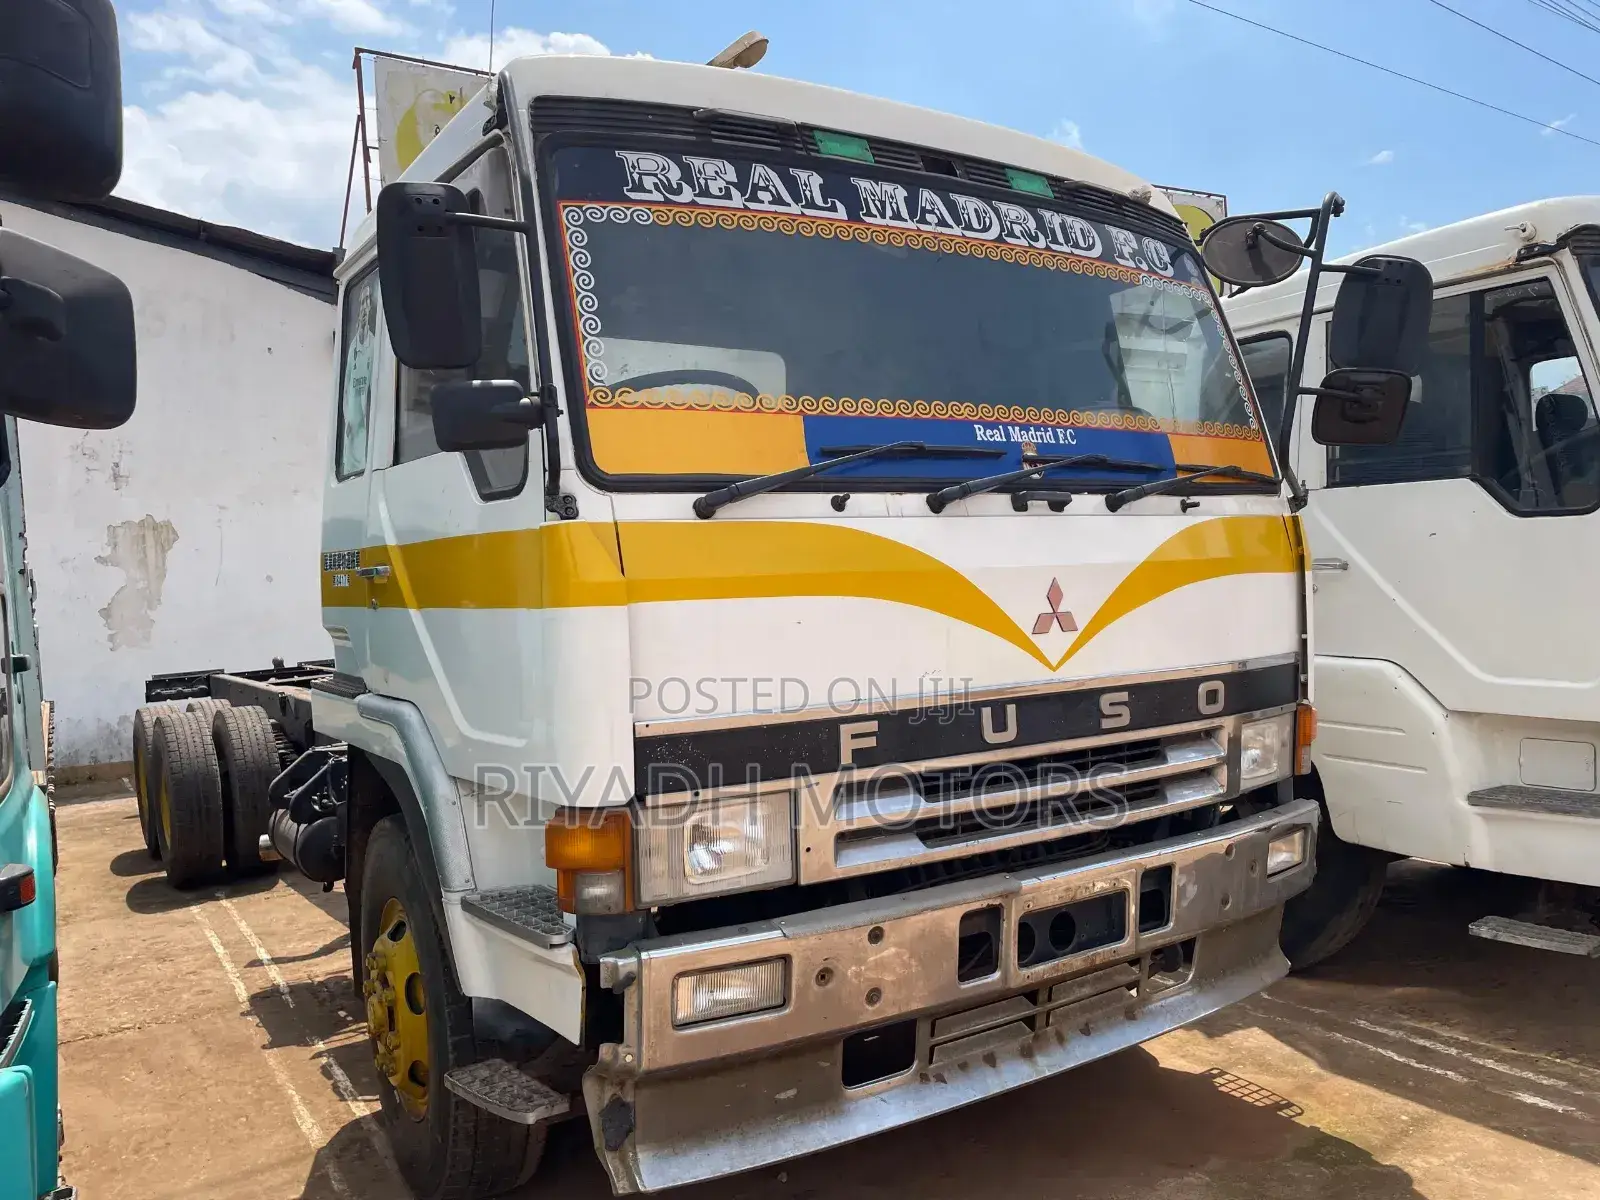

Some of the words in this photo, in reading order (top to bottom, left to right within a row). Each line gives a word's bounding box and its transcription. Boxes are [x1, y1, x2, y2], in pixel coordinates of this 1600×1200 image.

[615, 150, 848, 220] REAL
[851, 177, 1102, 258] MADRID
[974, 424, 1006, 441] Real
[1007, 426, 1056, 444] Madrid
